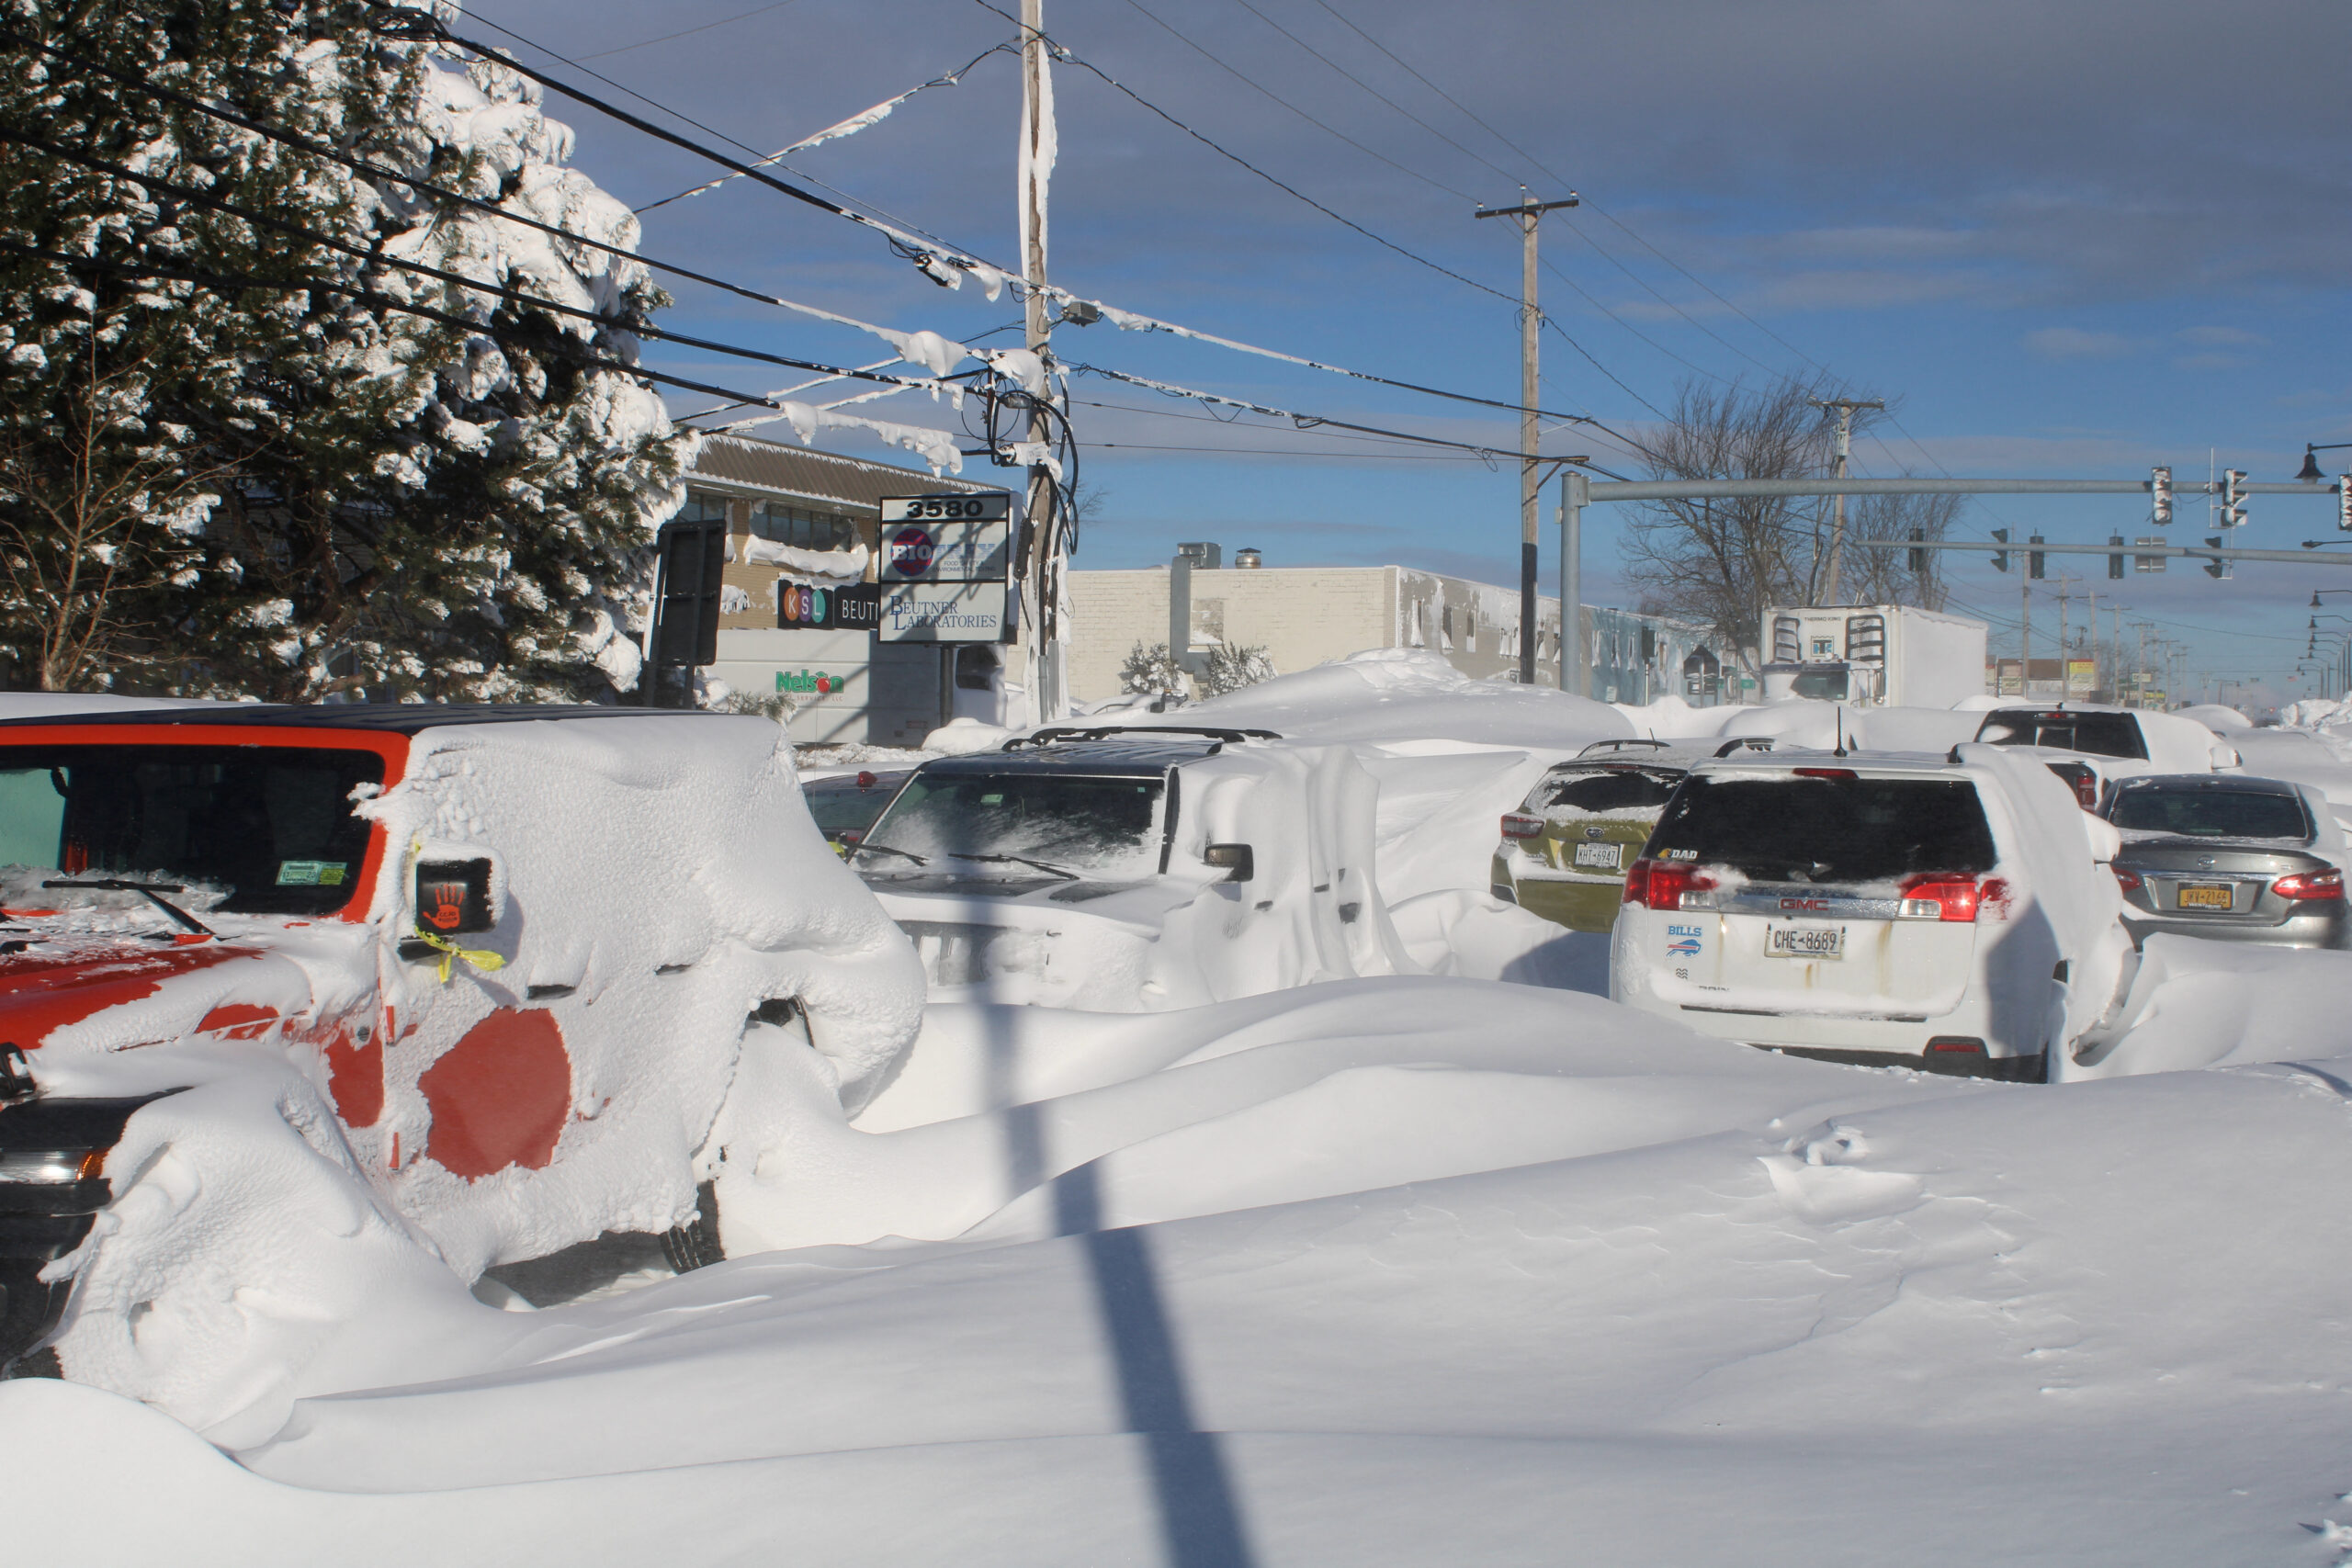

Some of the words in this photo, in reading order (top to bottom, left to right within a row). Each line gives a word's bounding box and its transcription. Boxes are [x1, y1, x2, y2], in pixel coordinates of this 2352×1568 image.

[907, 500, 984, 518] 3580
[842, 599, 878, 622] BEUT
[889, 595, 958, 615] BEUTNER
[893, 611, 997, 630] LABORATORIES
[1671, 849, 1699, 860] DAD
[1781, 898, 1829, 911] GMC
[1668, 926, 1702, 937] BILLS
